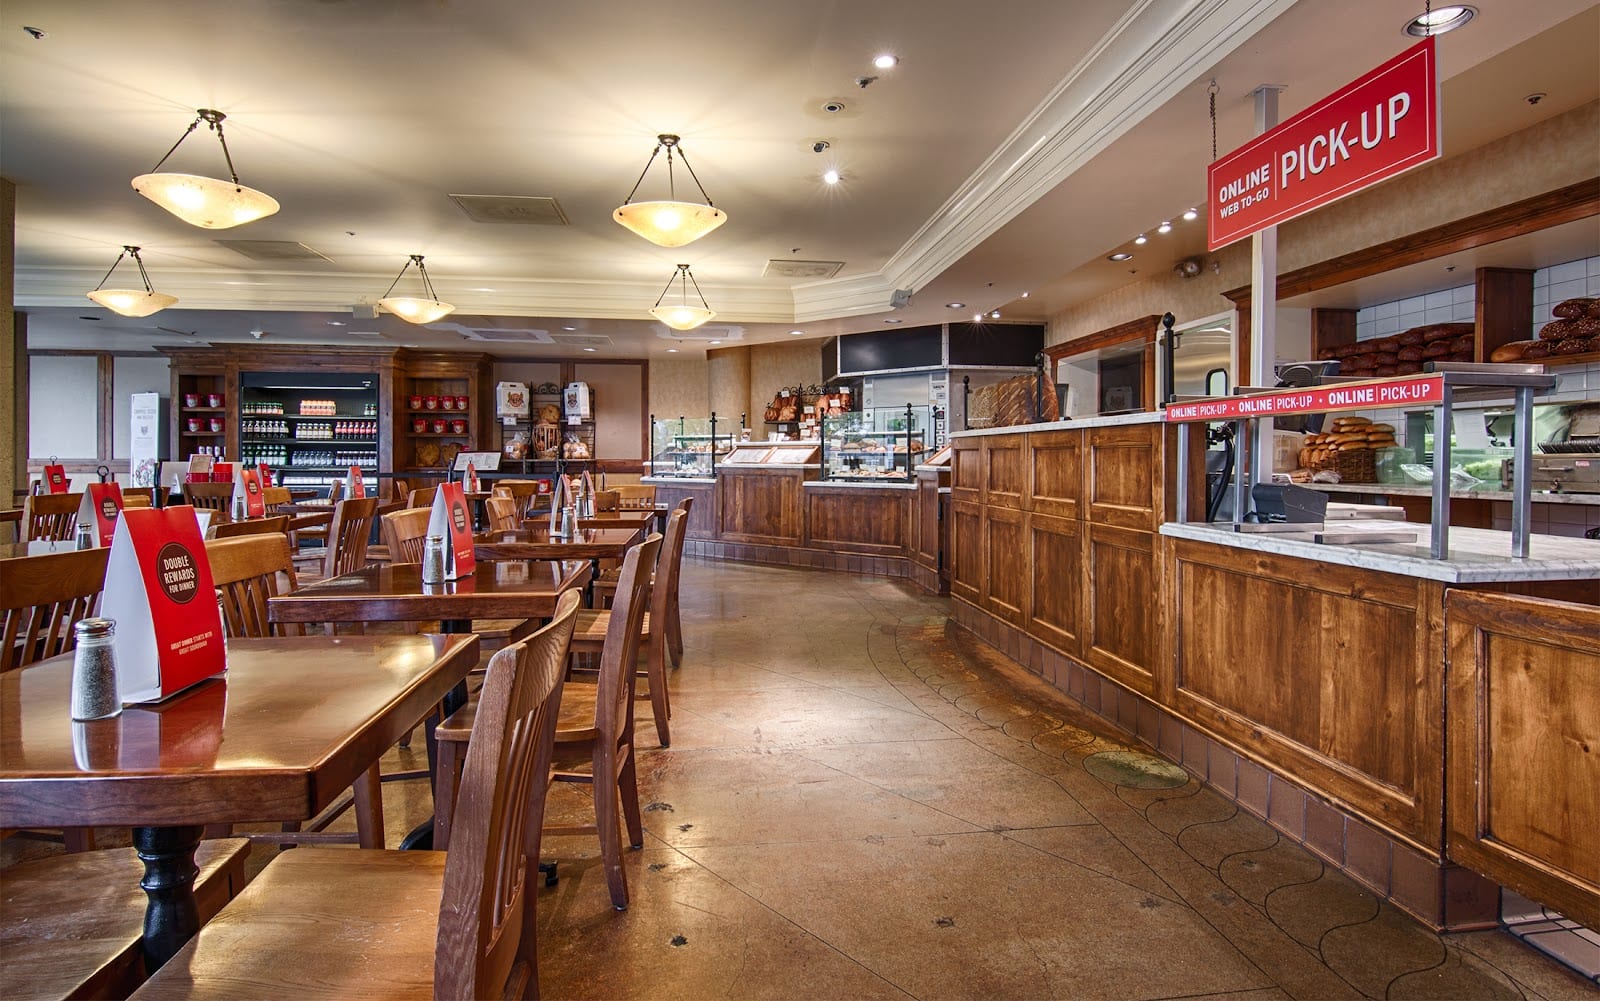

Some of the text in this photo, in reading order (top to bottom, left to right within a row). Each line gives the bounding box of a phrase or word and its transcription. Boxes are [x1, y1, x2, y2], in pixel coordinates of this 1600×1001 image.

[1281, 91, 1411, 189] PICK-UP
[1219, 163, 1270, 203] ONLINE
[1220, 187, 1269, 219] WEB TO-GO
[1171, 383, 1430, 418] ONLINE PICK-UP ONLINE PICK-UP ONLINE PICK-UP
[163, 555, 190, 570] DOUBLE
[163, 567, 196, 584] REWARDS
[169, 581, 195, 593] FOR DINNER
